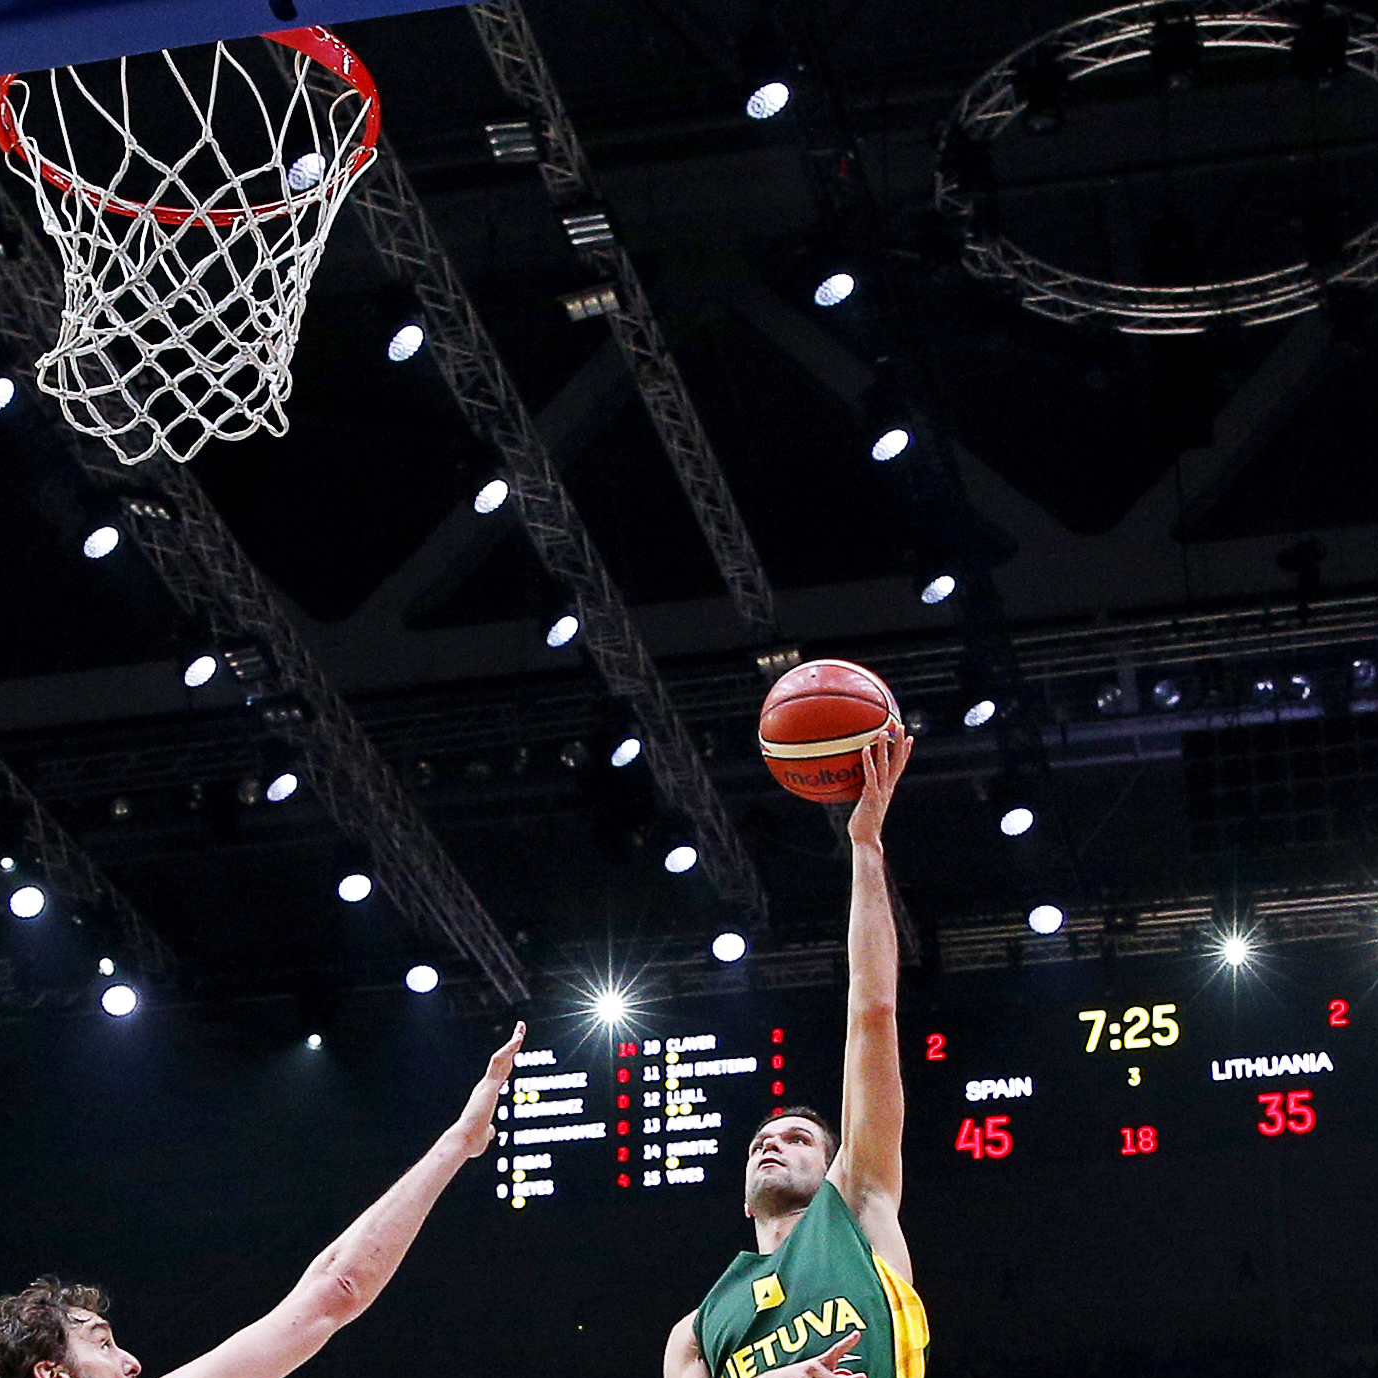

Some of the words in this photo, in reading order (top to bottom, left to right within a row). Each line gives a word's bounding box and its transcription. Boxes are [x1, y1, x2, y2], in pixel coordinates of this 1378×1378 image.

[1329, 999, 1349, 1026] 2
[643, 1040, 661, 1055] 10
[772, 1028, 784, 1043] 2
[1078, 1004, 1179, 1052] 7:25
[926, 1033, 946, 1060] 2
[643, 1066, 660, 1081] 11
[772, 1054, 784, 1069] 0
[1128, 1067, 1141, 1086] 3
[1212, 1052, 1333, 1080] LITHUANIA
[643, 1092, 660, 1107] 12
[966, 1076, 1032, 1101] SPAIN
[643, 1118, 660, 1133] 13
[1257, 1090, 1315, 1136] 35
[498, 1131, 508, 1146] 7
[955, 1115, 1013, 1159] 45
[1121, 1126, 1157, 1155] 18
[643, 1170, 661, 1186] 15
